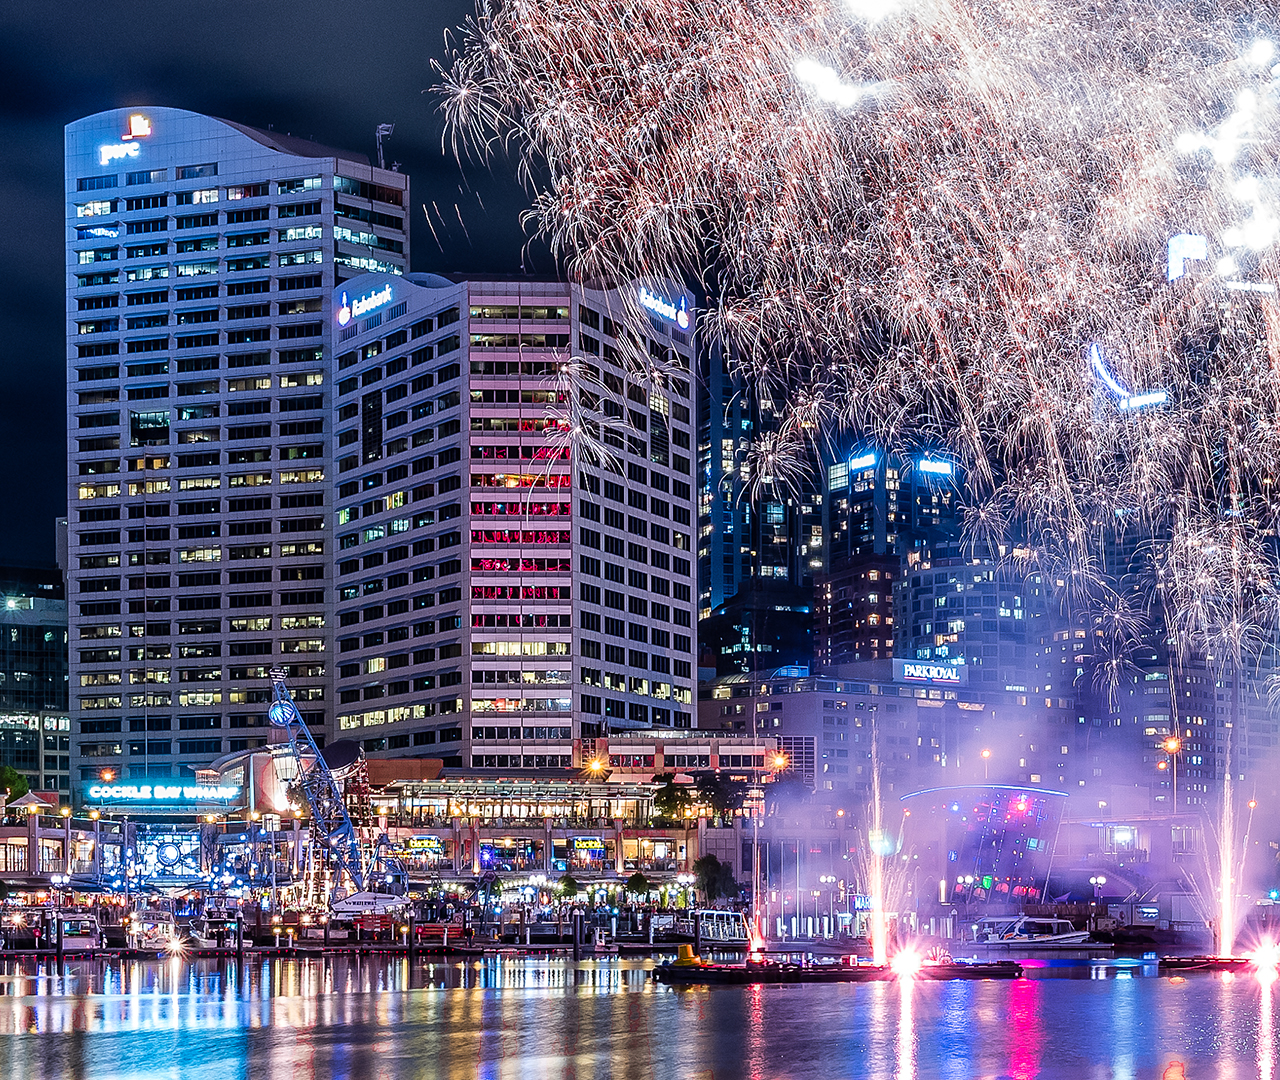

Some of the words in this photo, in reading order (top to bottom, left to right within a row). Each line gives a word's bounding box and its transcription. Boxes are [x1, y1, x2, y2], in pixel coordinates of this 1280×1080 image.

[100, 142, 140, 165] pwc
[352, 284, 392, 318] Rabobank
[904, 664, 960, 679] PARKROYAL
[89, 785, 152, 799] COCKLE
[154, 785, 182, 799] BAY
[183, 785, 239, 799] WHARF
